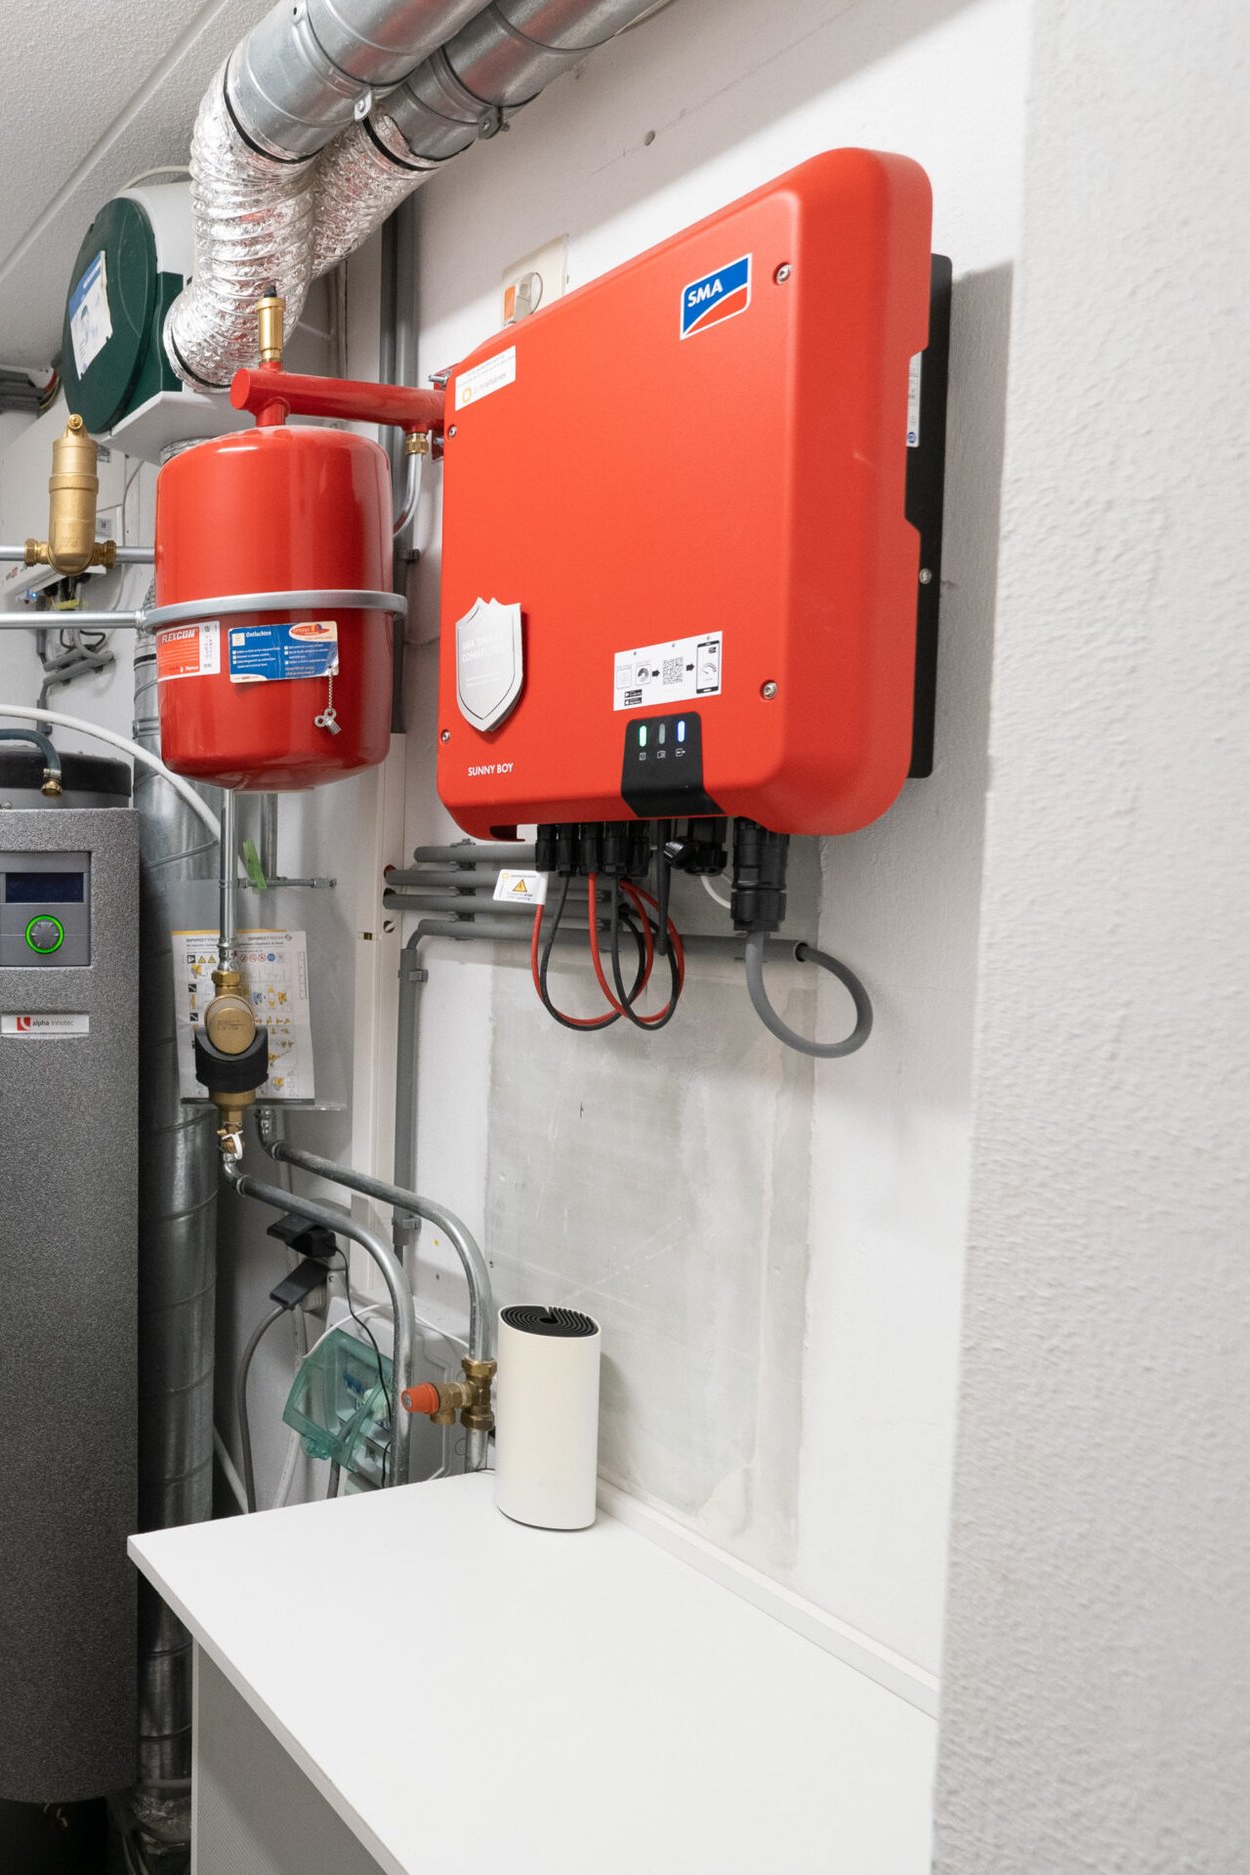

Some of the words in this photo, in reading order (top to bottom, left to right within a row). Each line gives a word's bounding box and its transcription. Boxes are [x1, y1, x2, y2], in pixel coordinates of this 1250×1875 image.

[687, 278, 724, 307] SMA
[467, 764, 496, 777] SUNNY
[496, 762, 514, 774] BOY
[32, 1019, 50, 1028] alpha
